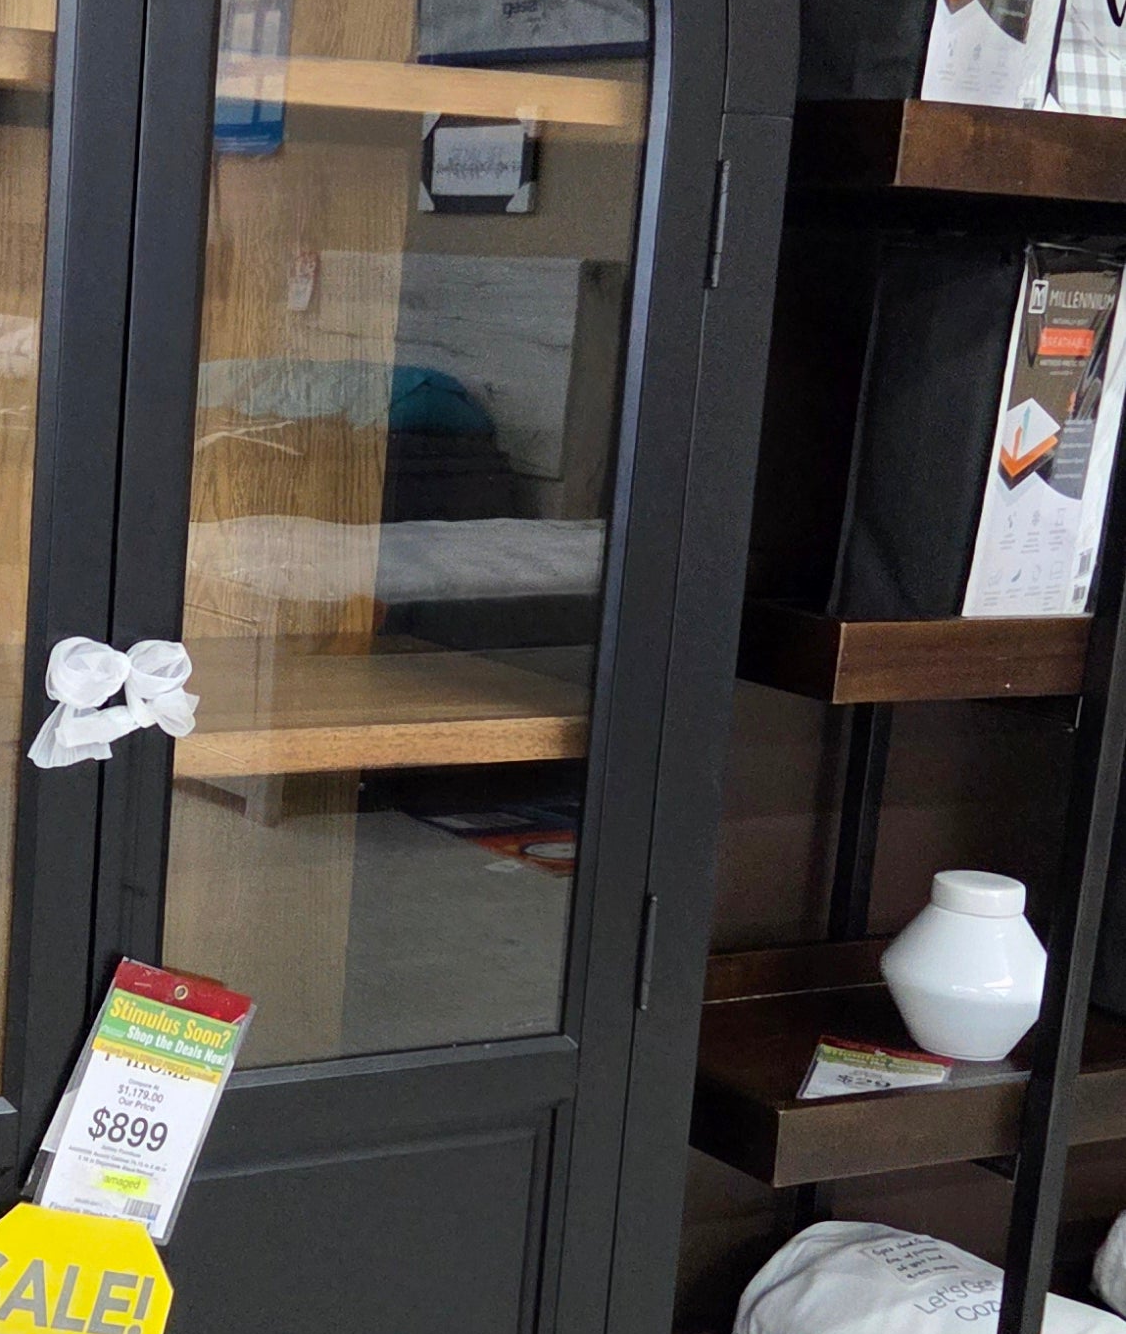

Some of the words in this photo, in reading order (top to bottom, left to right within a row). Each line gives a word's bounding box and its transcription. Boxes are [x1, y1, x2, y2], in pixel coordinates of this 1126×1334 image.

[1049, 289, 1116, 311] MILLENNIUM
[110, 997, 181, 1036] Stimulus
[183, 1018, 232, 1050] Soon?
[126, 1025, 154, 1047] Shop
[155, 1034, 173, 1051] the
[175, 1039, 203, 1060] Deals
[118, 1096, 133, 1107] Our
[134, 1100, 156, 1113] Price
[87, 1106, 168, 1152] $899
[102, 1174, 141, 1189] amaged
[914, 1284, 968, 1314] Let's
